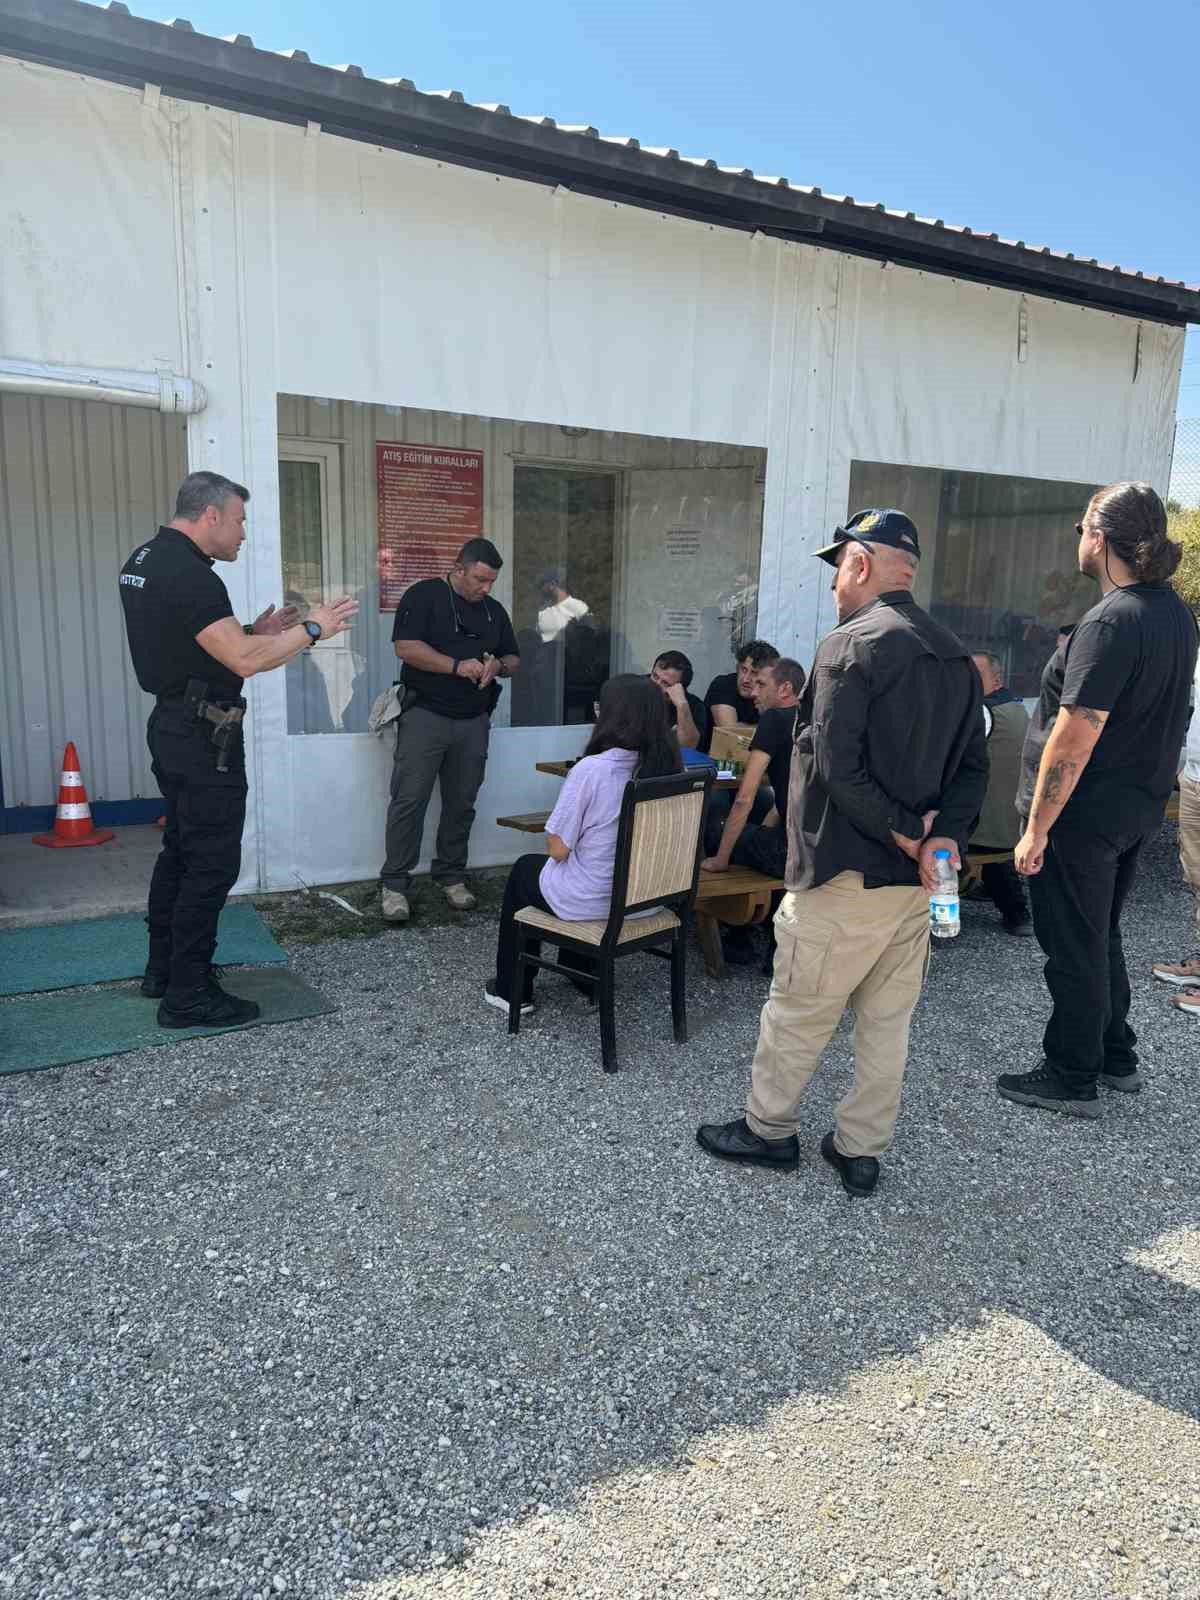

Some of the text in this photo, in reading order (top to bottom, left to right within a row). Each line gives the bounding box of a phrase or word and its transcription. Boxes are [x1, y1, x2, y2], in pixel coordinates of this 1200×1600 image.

[383, 450, 479, 469] ATIŞ EĞİTİM KURALLARI
